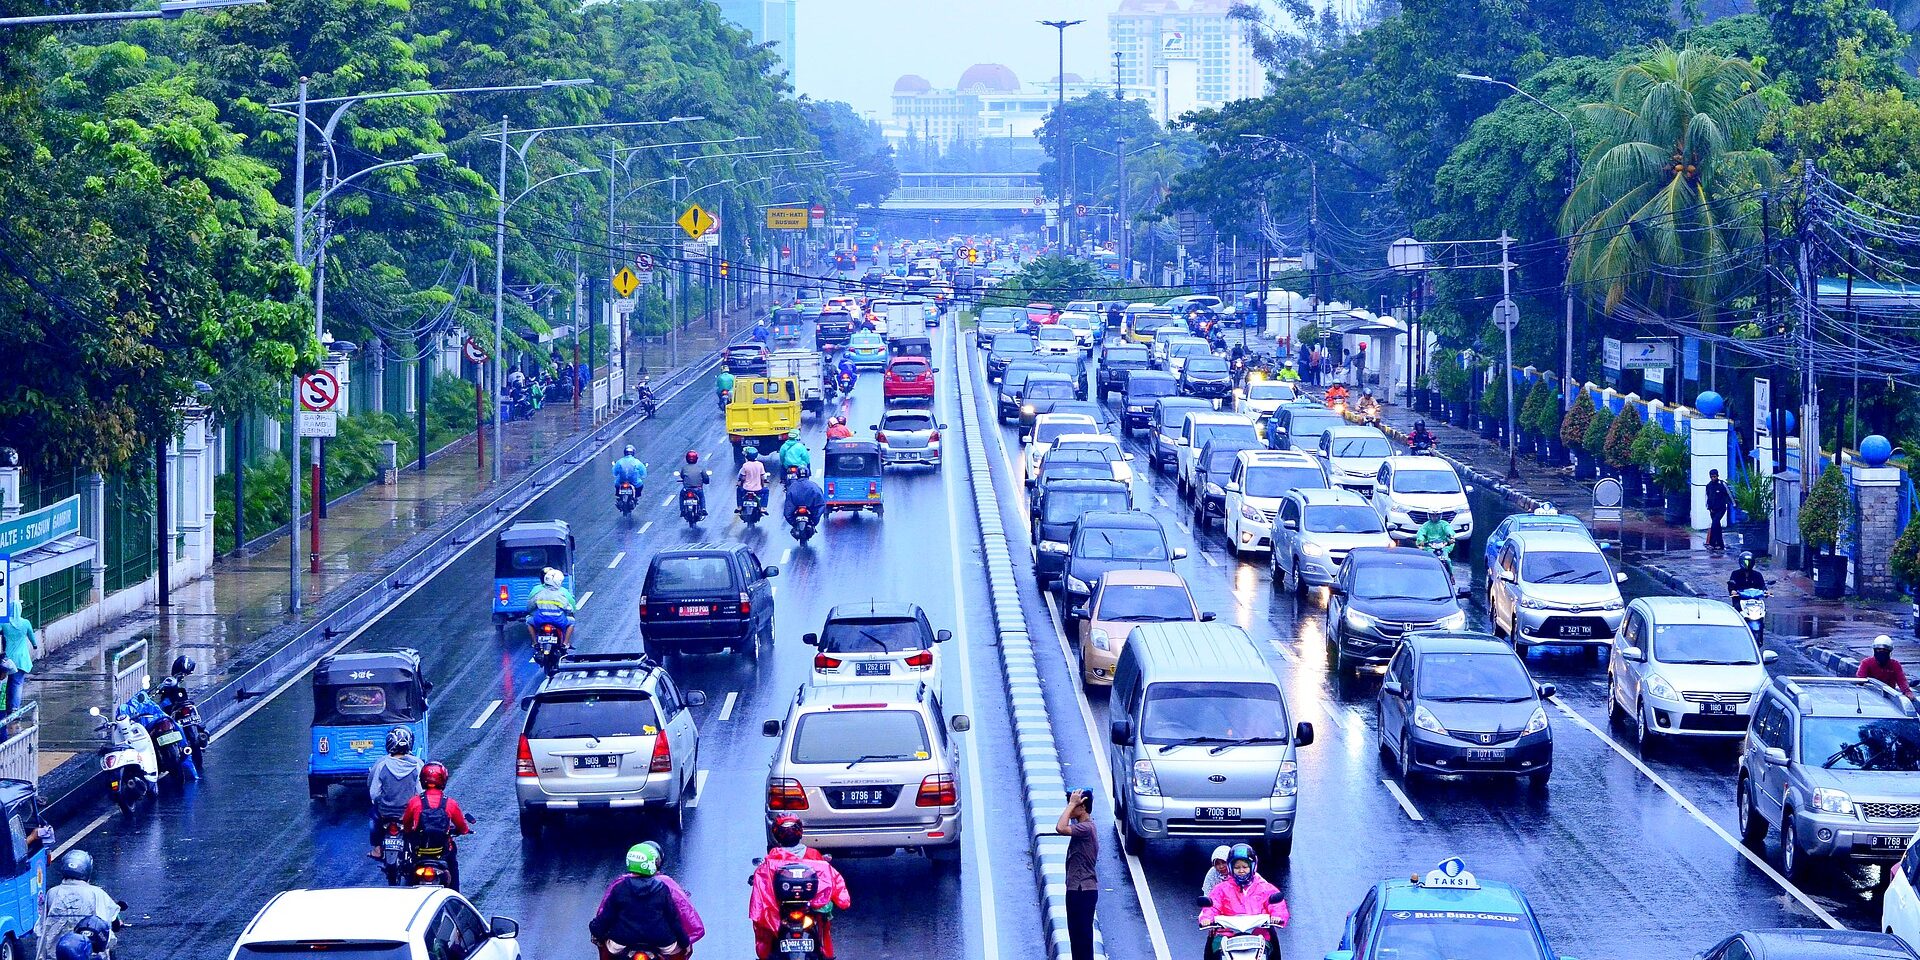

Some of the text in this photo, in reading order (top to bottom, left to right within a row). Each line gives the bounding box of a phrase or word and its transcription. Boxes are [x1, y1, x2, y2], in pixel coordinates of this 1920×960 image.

[310, 377, 328, 404] S
[1700, 703, 1705, 711] B
[1477, 750, 1491, 758] 1071
[574, 756, 616, 766] B 1909 XG
[851, 791, 869, 800] 8796
[1195, 807, 1201, 816] B
[1208, 807, 1225, 816] 7006
[1872, 836, 1878, 846] B
[1884, 837, 1901, 846] 1768
[1434, 877, 1469, 886] TAKSI
[1414, 911, 1520, 923] BLUE BIRD GROUP
